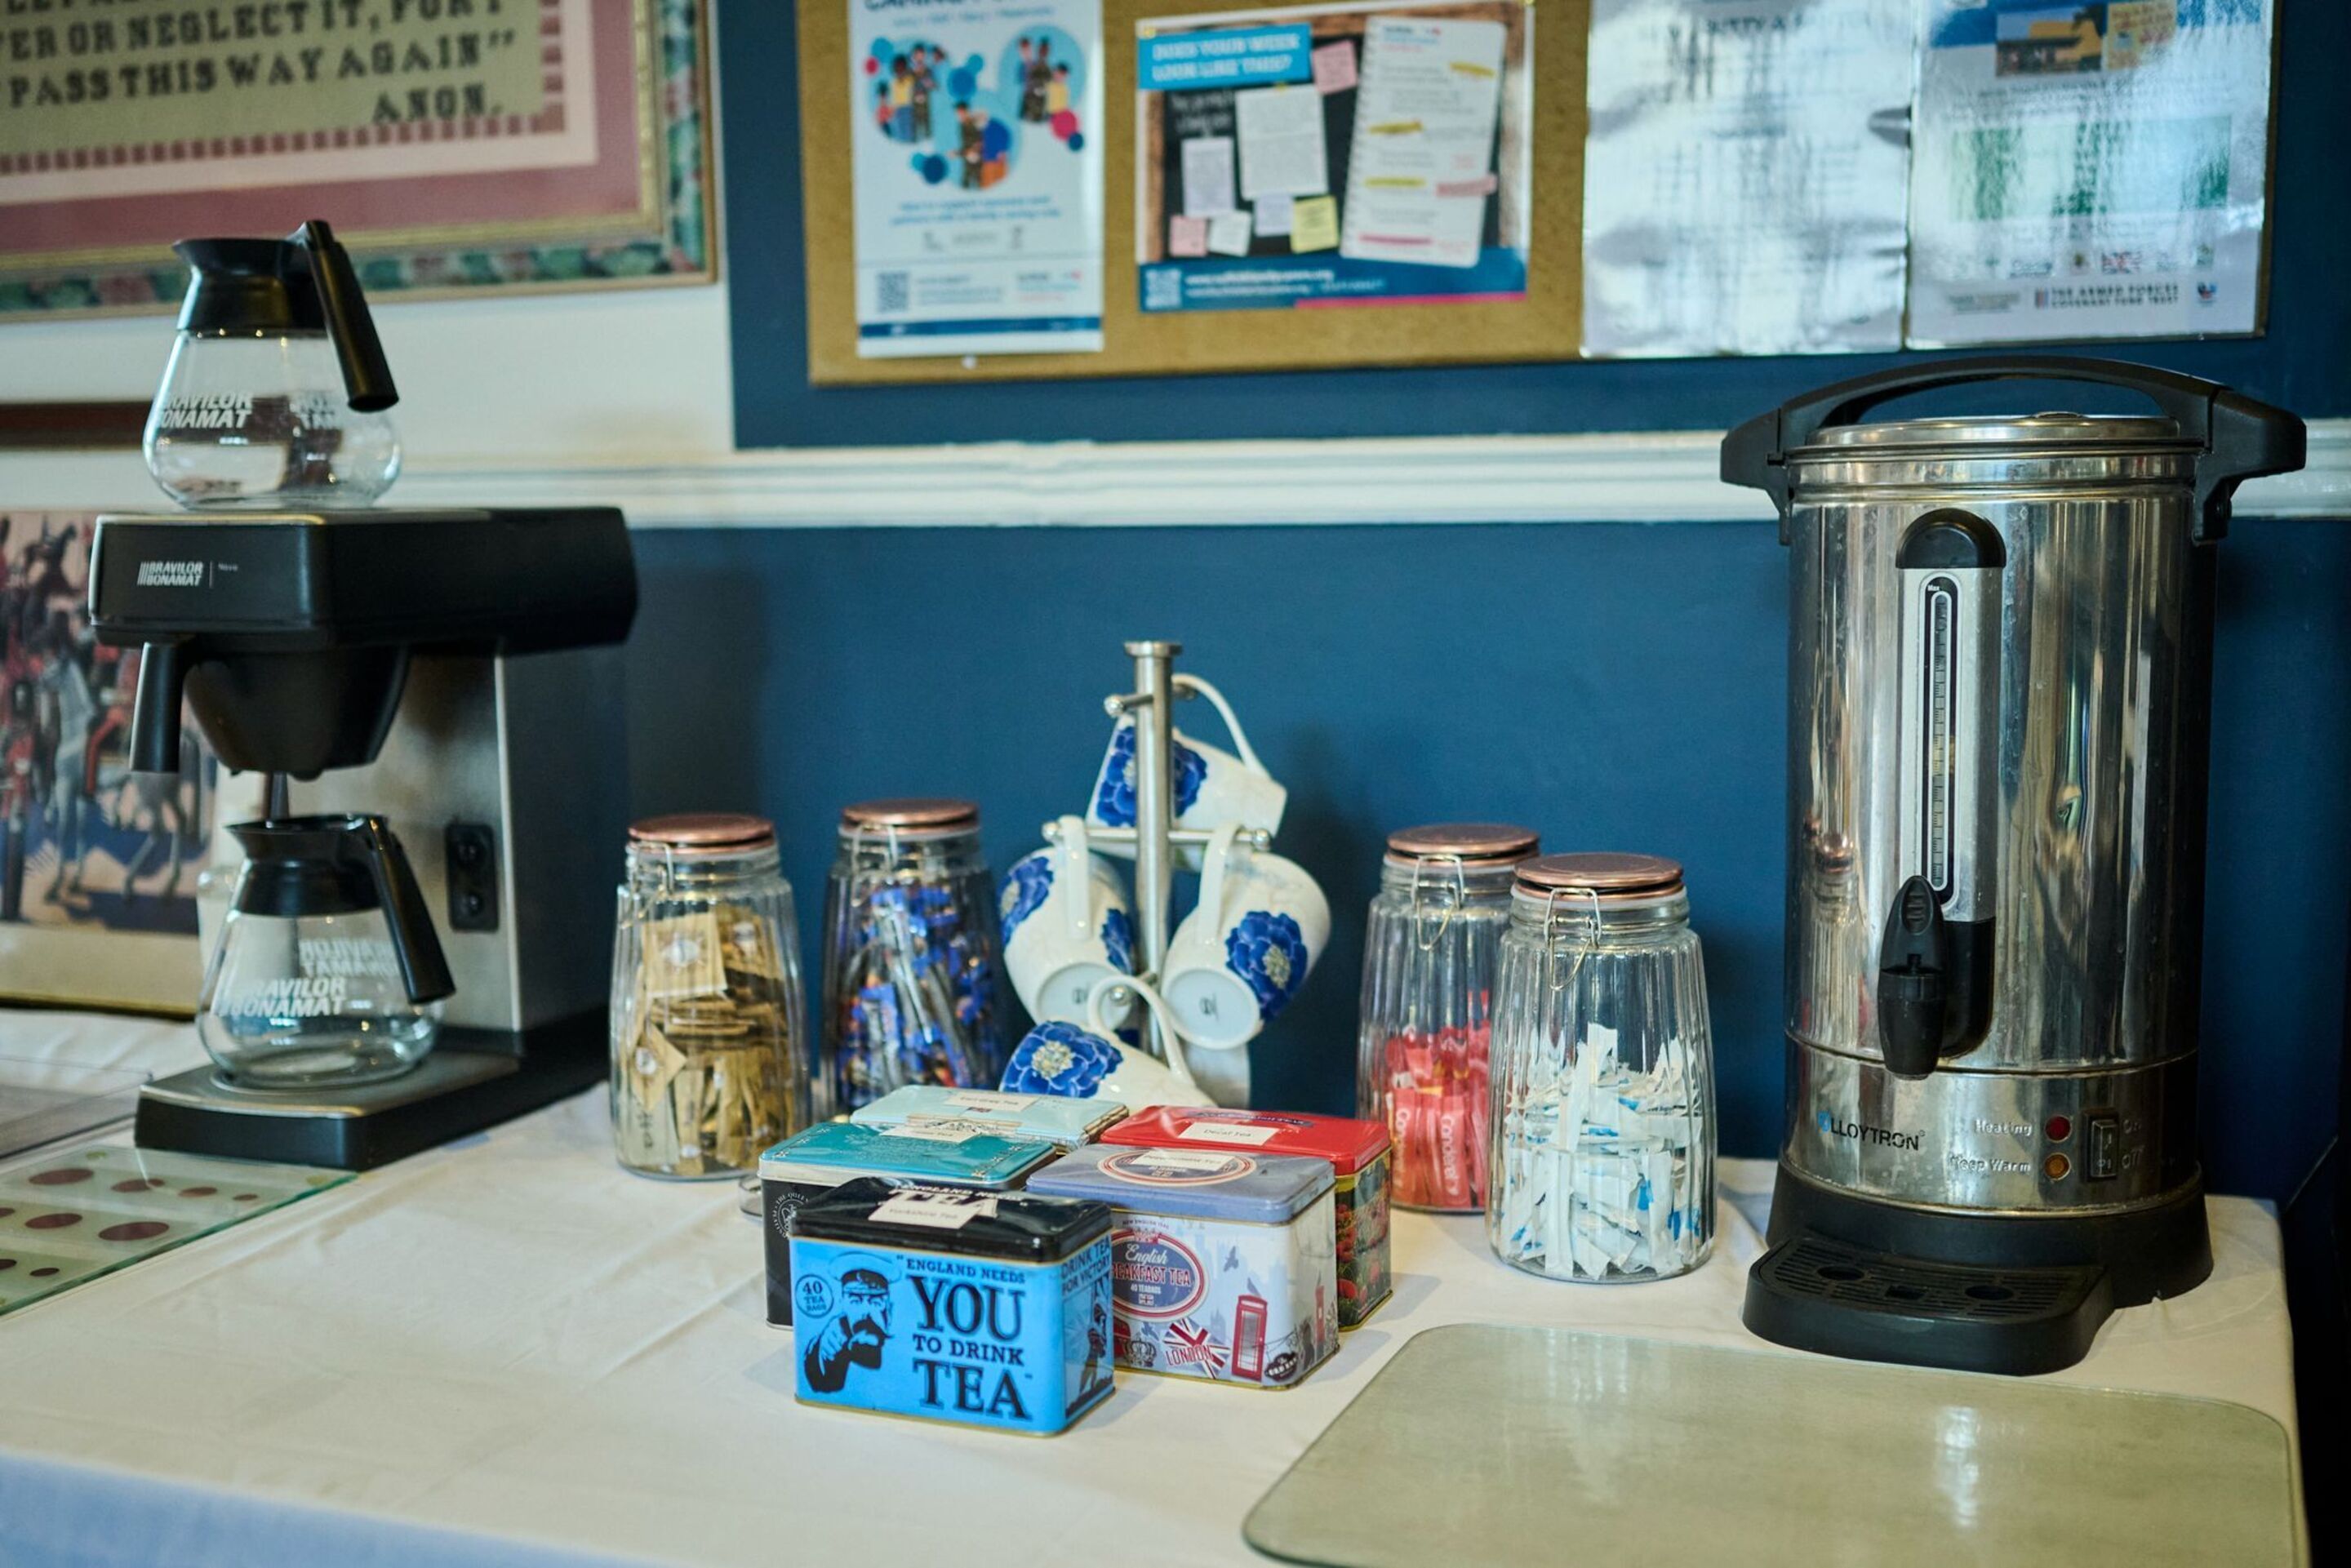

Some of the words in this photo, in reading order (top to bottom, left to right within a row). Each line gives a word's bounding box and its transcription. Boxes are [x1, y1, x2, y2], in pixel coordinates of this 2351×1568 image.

[68, 20, 117, 56] OR
[127, 1, 309, 51] NEGLECT
[8, 67, 113, 109] PASS
[118, 57, 217, 100] THIS
[225, 47, 323, 90] WAY
[160, 410, 252, 429] ONAMAT
[1973, 1119, 2033, 1137] Heating
[1989, 1158, 2032, 1172] Warm
[1124, 1242, 1169, 1266] English
[981, 1269, 1026, 1285] NEEDS
[1113, 1261, 1167, 1284] REAKFAST
[1169, 1267, 1193, 1287] TEA
[802, 1280, 824, 1295] 40
[802, 1295, 825, 1304] TEA
[906, 1273, 1027, 1343] YOU
[912, 1333, 942, 1353] TO
[949, 1339, 1025, 1367] DRINK
[1165, 1345, 1213, 1367] LONDON
